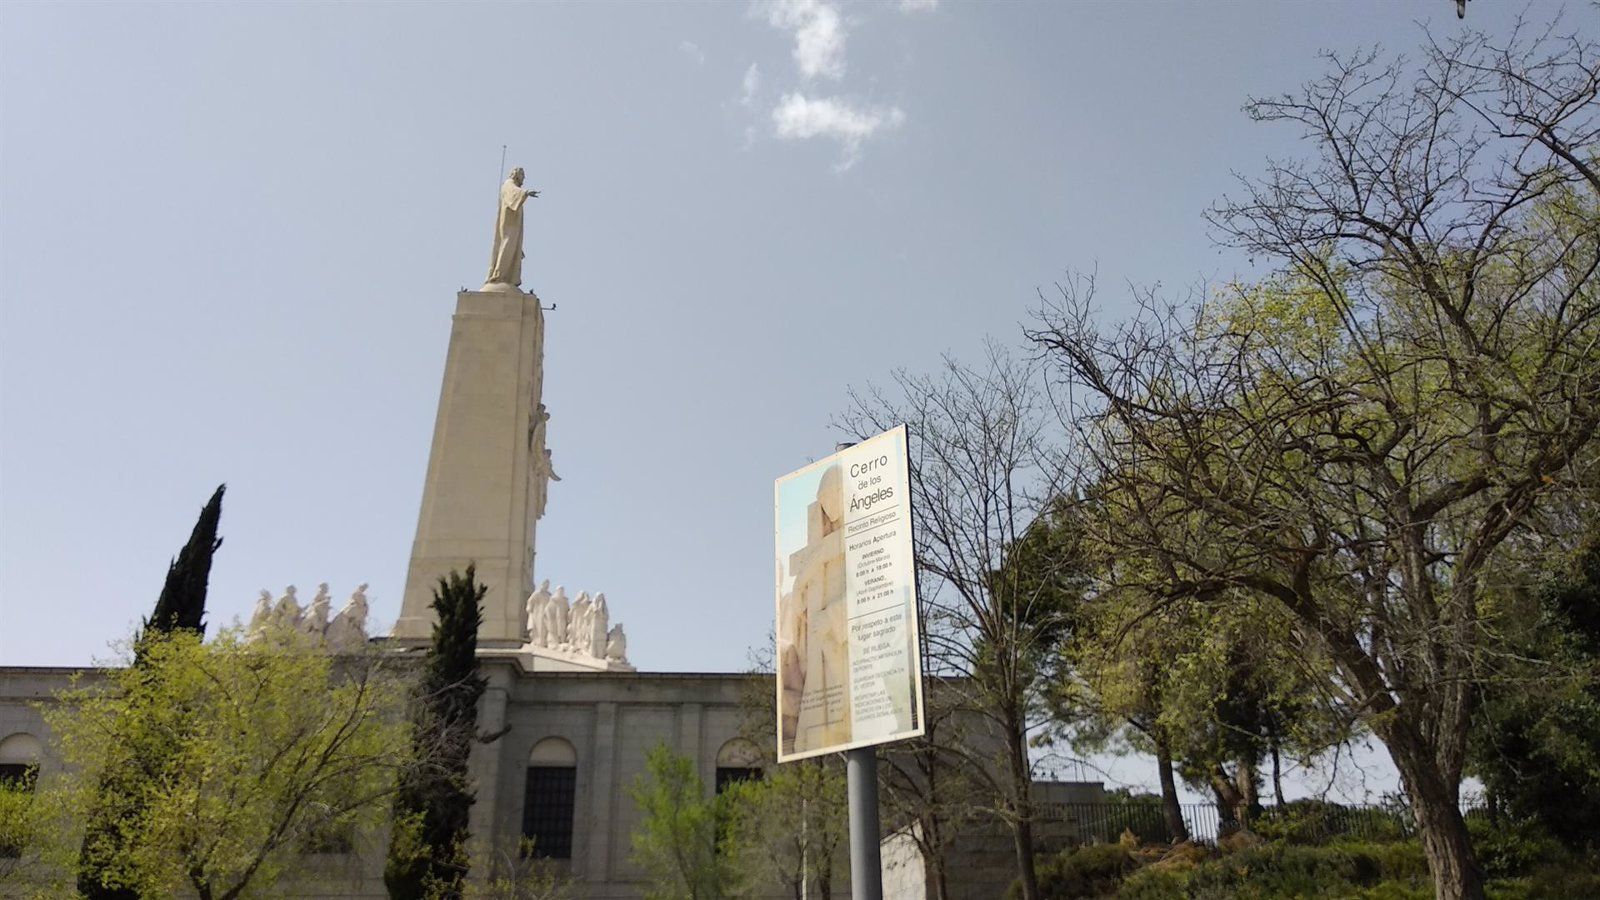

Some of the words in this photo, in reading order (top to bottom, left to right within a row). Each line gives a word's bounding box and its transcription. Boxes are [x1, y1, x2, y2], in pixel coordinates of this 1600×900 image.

[850, 455, 888, 478] Cerro
[858, 480, 868, 490] de
[869, 475, 881, 486] los
[850, 486, 894, 512] Ángeles
[848, 522, 869, 533] Recinto
[870, 512, 896, 526] Religioso
[849, 540, 872, 551] Horarios
[873, 530, 896, 543] Apertura
[862, 548, 884, 559] INVIERNO
[852, 624, 861, 633] Por
